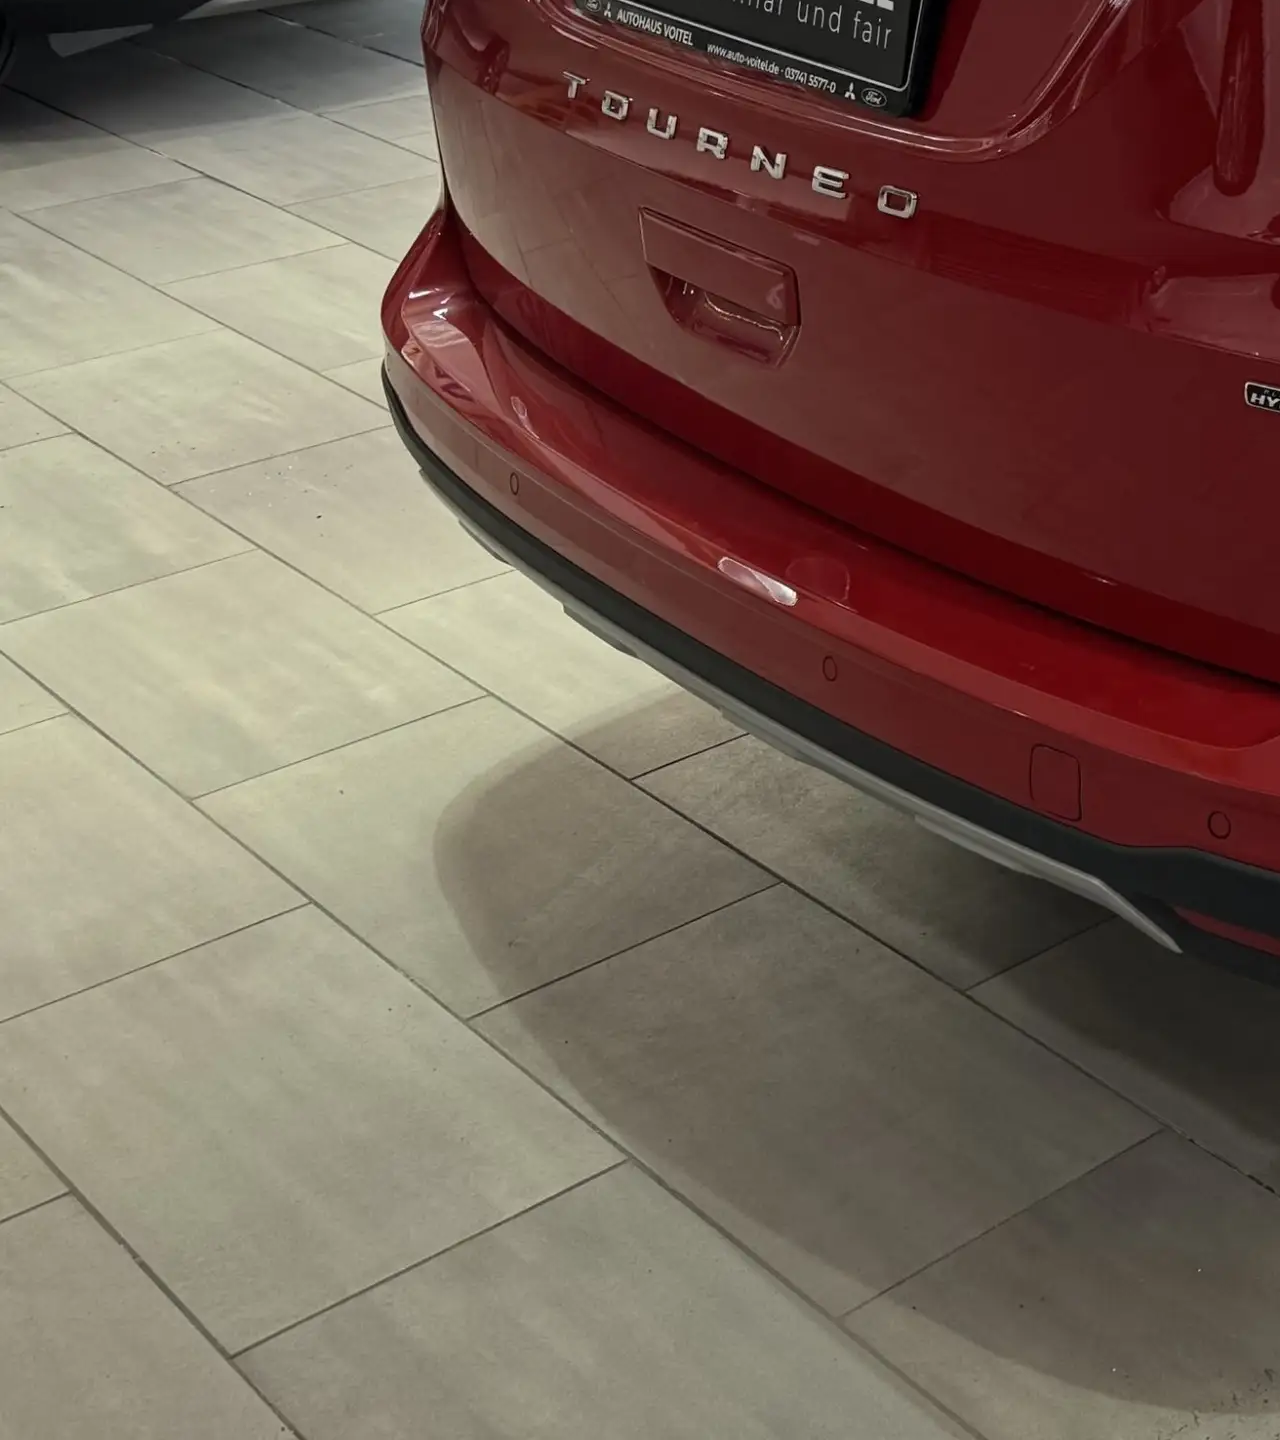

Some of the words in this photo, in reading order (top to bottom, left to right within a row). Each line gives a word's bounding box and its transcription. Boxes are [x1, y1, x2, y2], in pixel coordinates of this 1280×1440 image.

[616, 10, 663, 36] AUTOHAUS
[664, 23, 694, 47] VOITEL
[797, 0, 842, 34] und
[853, 10, 892, 50] fair
[706, 43, 780, 75] www.auto-voitel.de
[808, 77, 837, 95] 5577-0
[562, 71, 919, 220] TOURNEO
